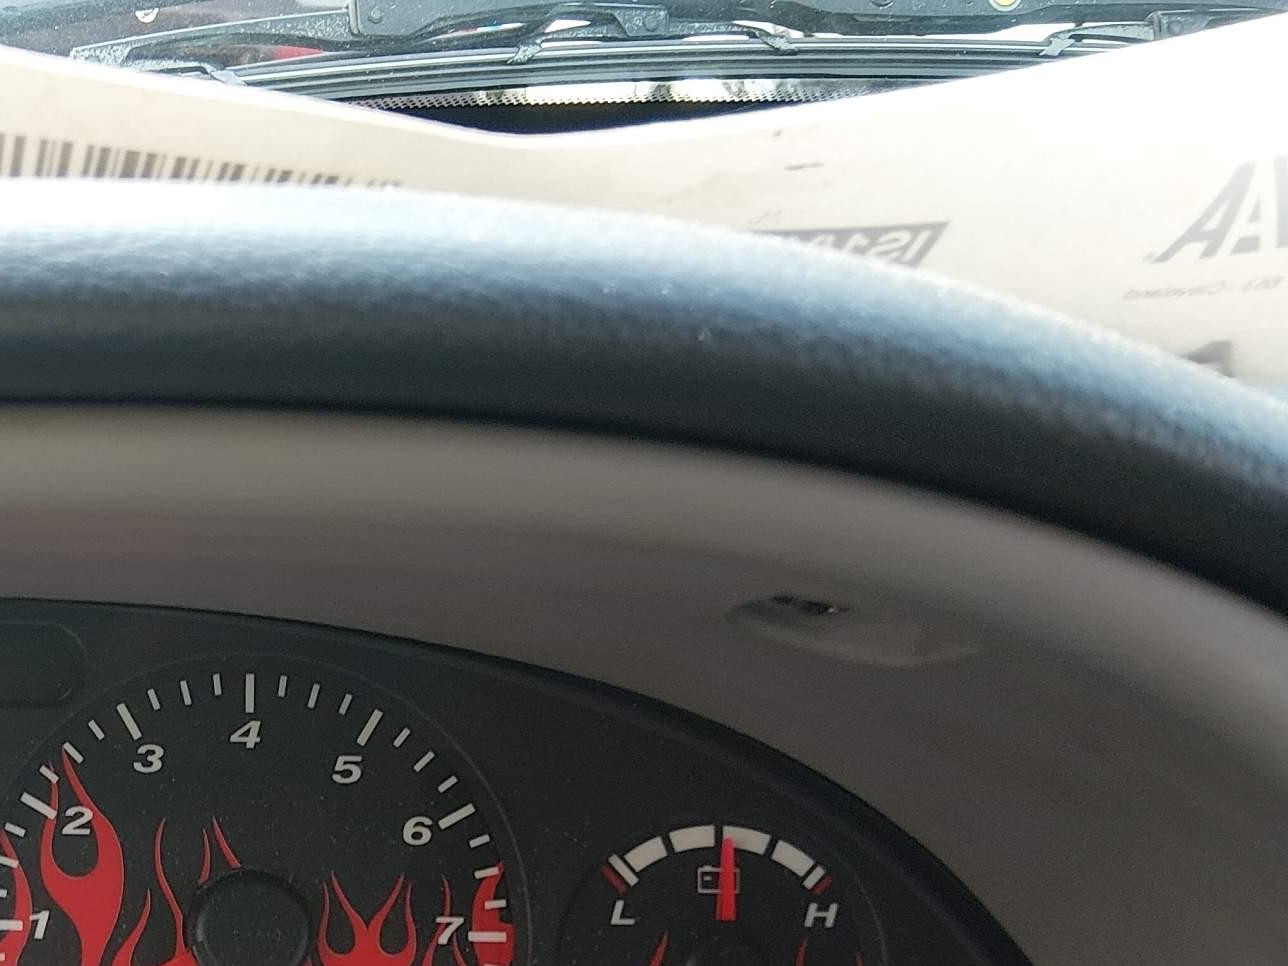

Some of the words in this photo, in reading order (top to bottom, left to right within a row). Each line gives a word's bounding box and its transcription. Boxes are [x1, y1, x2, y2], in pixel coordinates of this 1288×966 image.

[229, 720, 262, 749] 4
[133, 743, 165, 774] 3
[331, 755, 363, 784] 5
[62, 806, 94, 835] 2
[402, 816, 434, 845] 6
[29, 910, 50, 940] 1
[610, 900, 636, 926] L
[804, 903, 839, 928] H
[435, 916, 465, 945] 7
